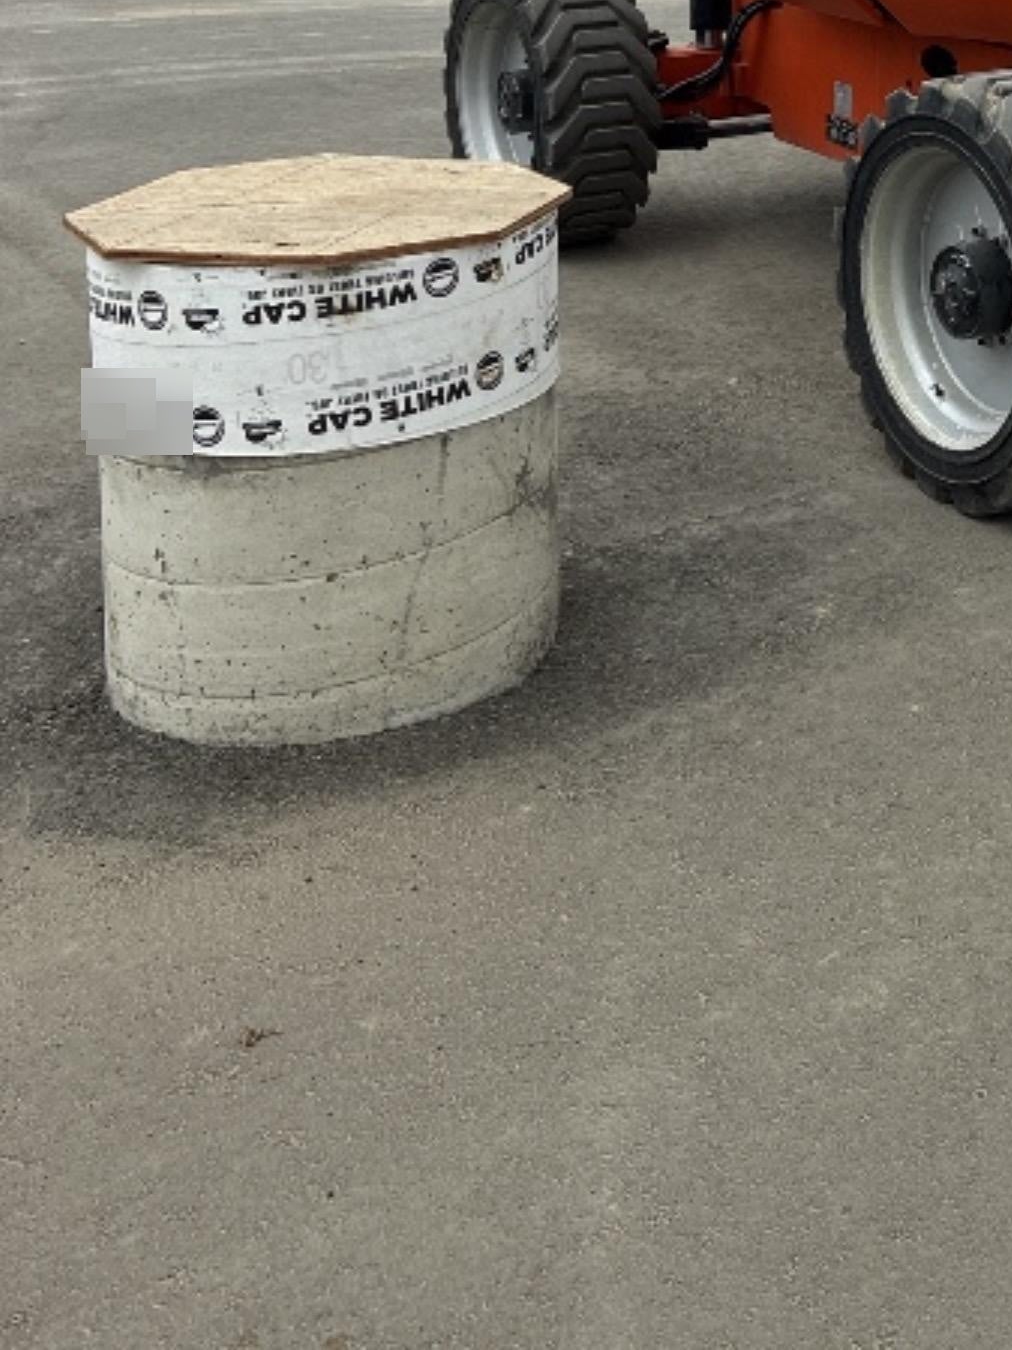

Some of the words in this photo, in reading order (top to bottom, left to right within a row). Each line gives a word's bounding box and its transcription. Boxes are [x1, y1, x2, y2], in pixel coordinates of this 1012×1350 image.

[242, 300, 306, 325] CAP
[314, 281, 417, 319] WHITE
[379, 378, 471, 421] WHITE
[308, 406, 372, 435] CAP
